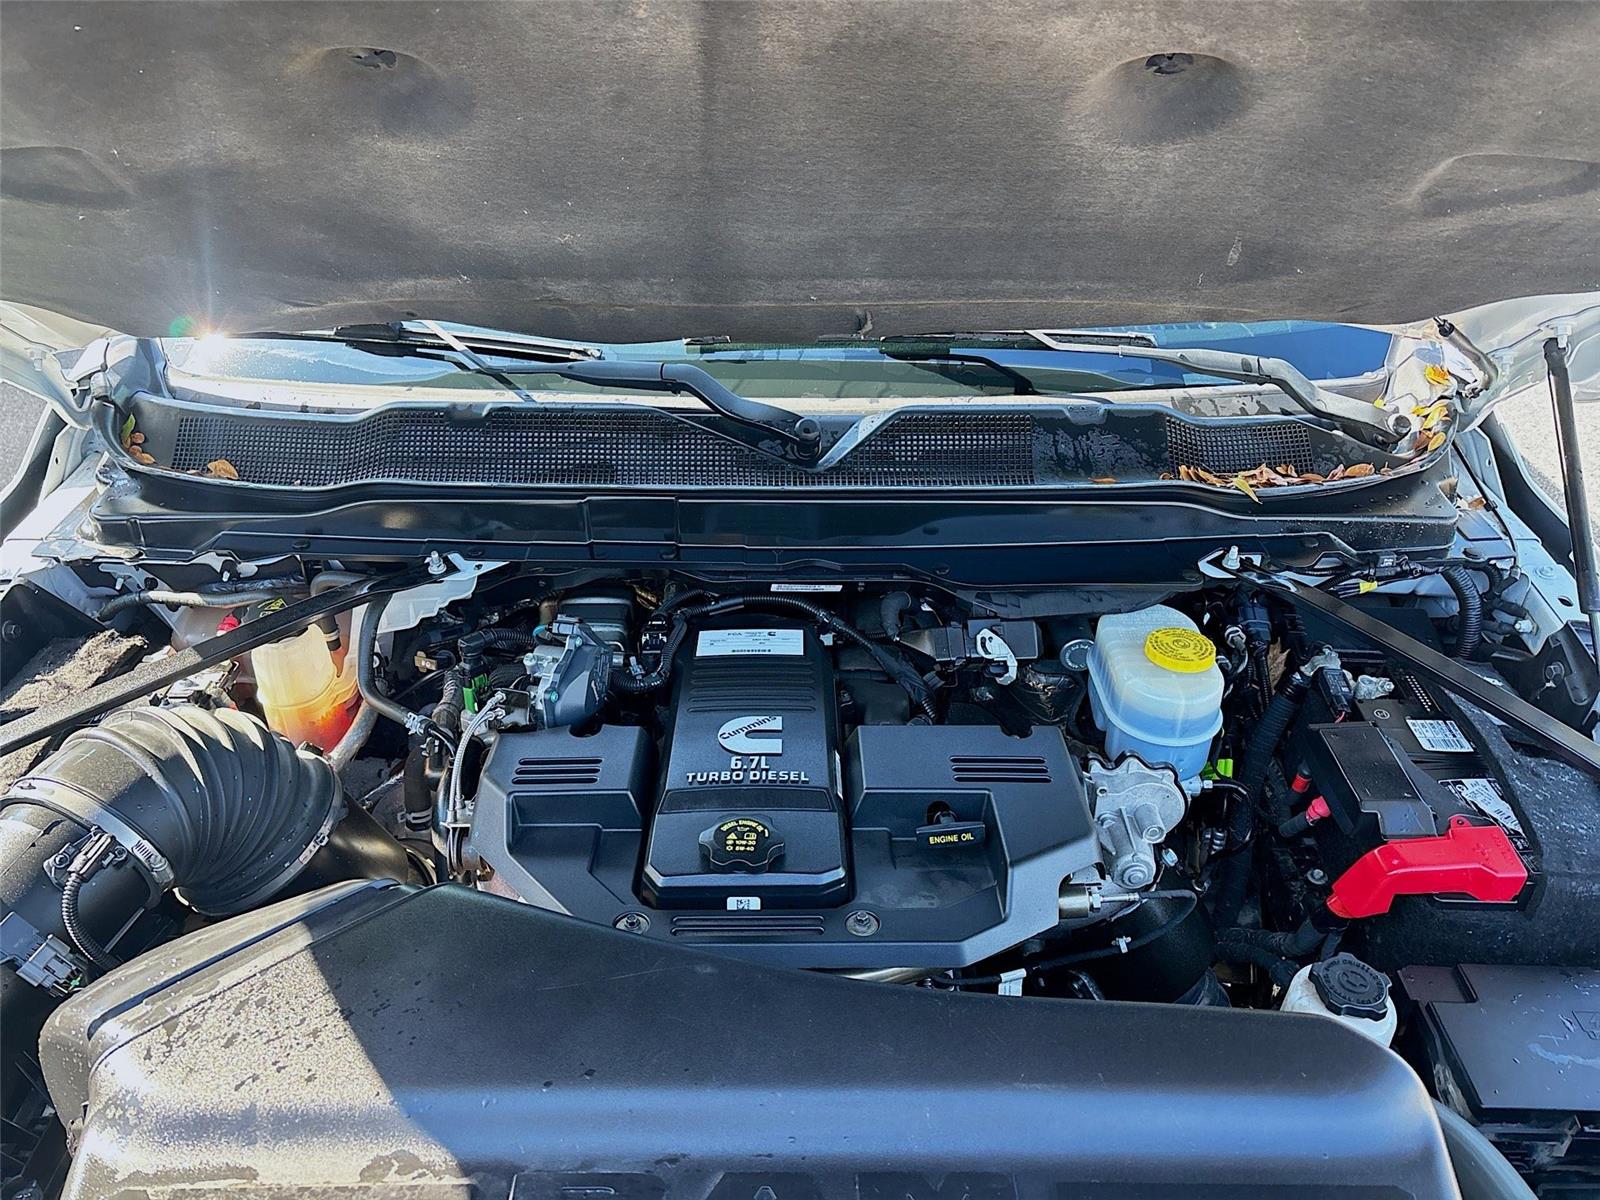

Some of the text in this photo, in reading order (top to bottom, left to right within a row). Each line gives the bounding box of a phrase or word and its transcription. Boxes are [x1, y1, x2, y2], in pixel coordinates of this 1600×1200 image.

[719, 716, 777, 740] Cummins
[730, 755, 770, 770] 6.7L
[686, 770, 809, 783] TURBO DIESEL
[928, 832, 975, 845] ENGINE OIL
